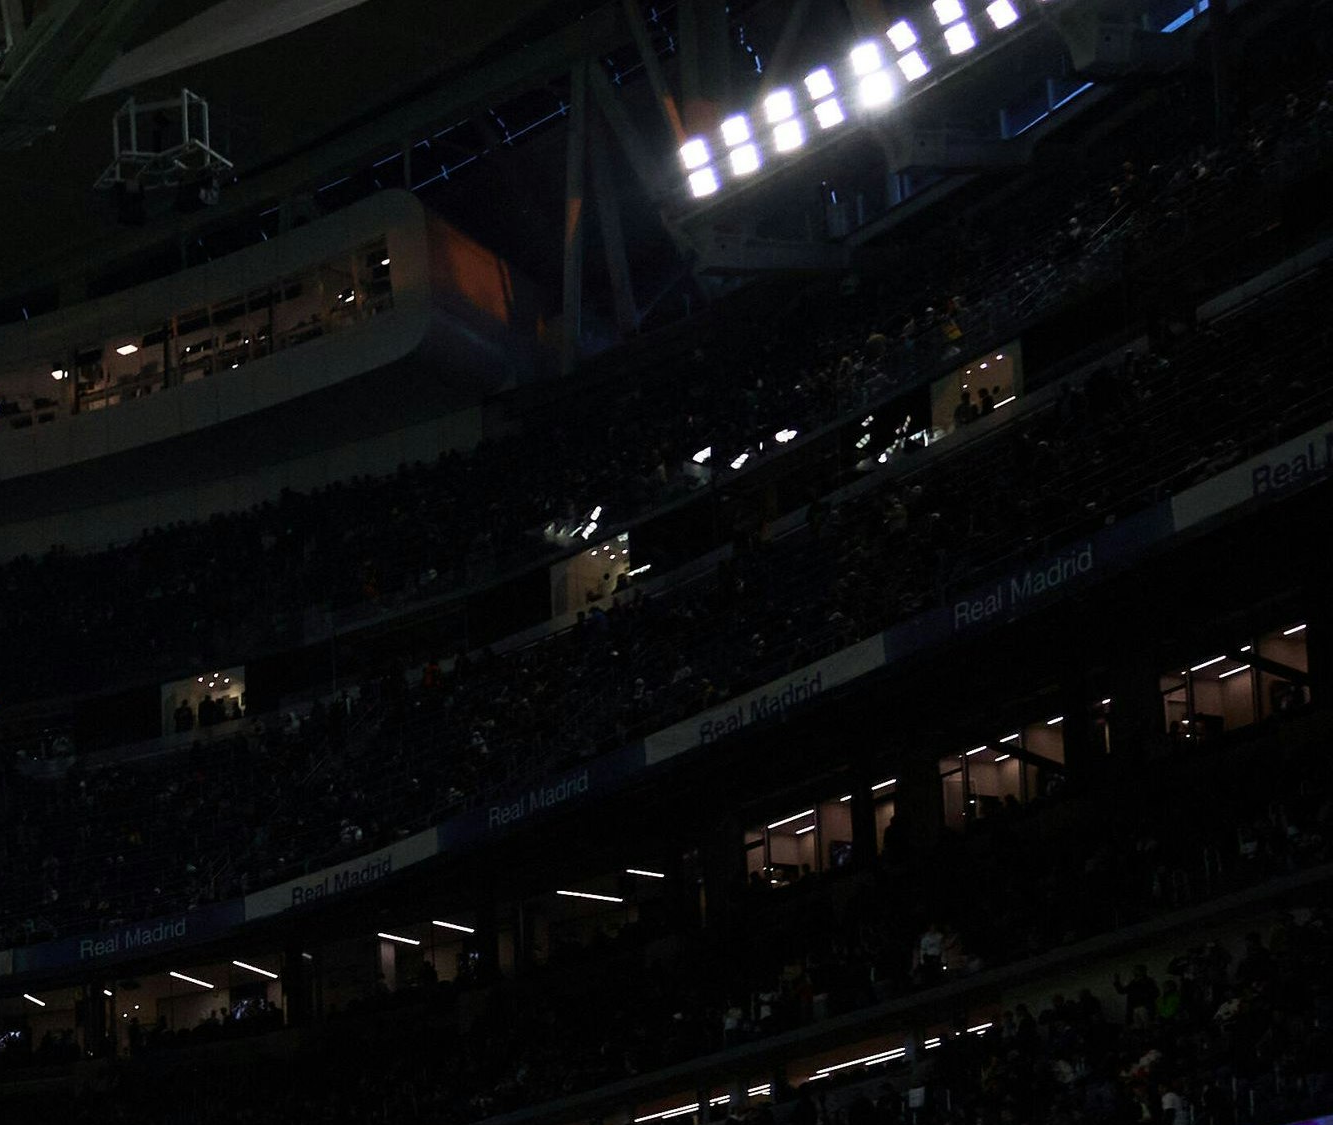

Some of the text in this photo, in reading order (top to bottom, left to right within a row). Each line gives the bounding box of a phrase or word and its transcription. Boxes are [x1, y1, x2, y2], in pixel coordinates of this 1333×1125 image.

[954, 544, 1094, 629] Real Madrid
[699, 672, 822, 744] Real Madrid
[488, 771, 590, 829] Real Madrid
[292, 856, 393, 905] Real Madrid
[80, 918, 187, 959] Real Madrid
